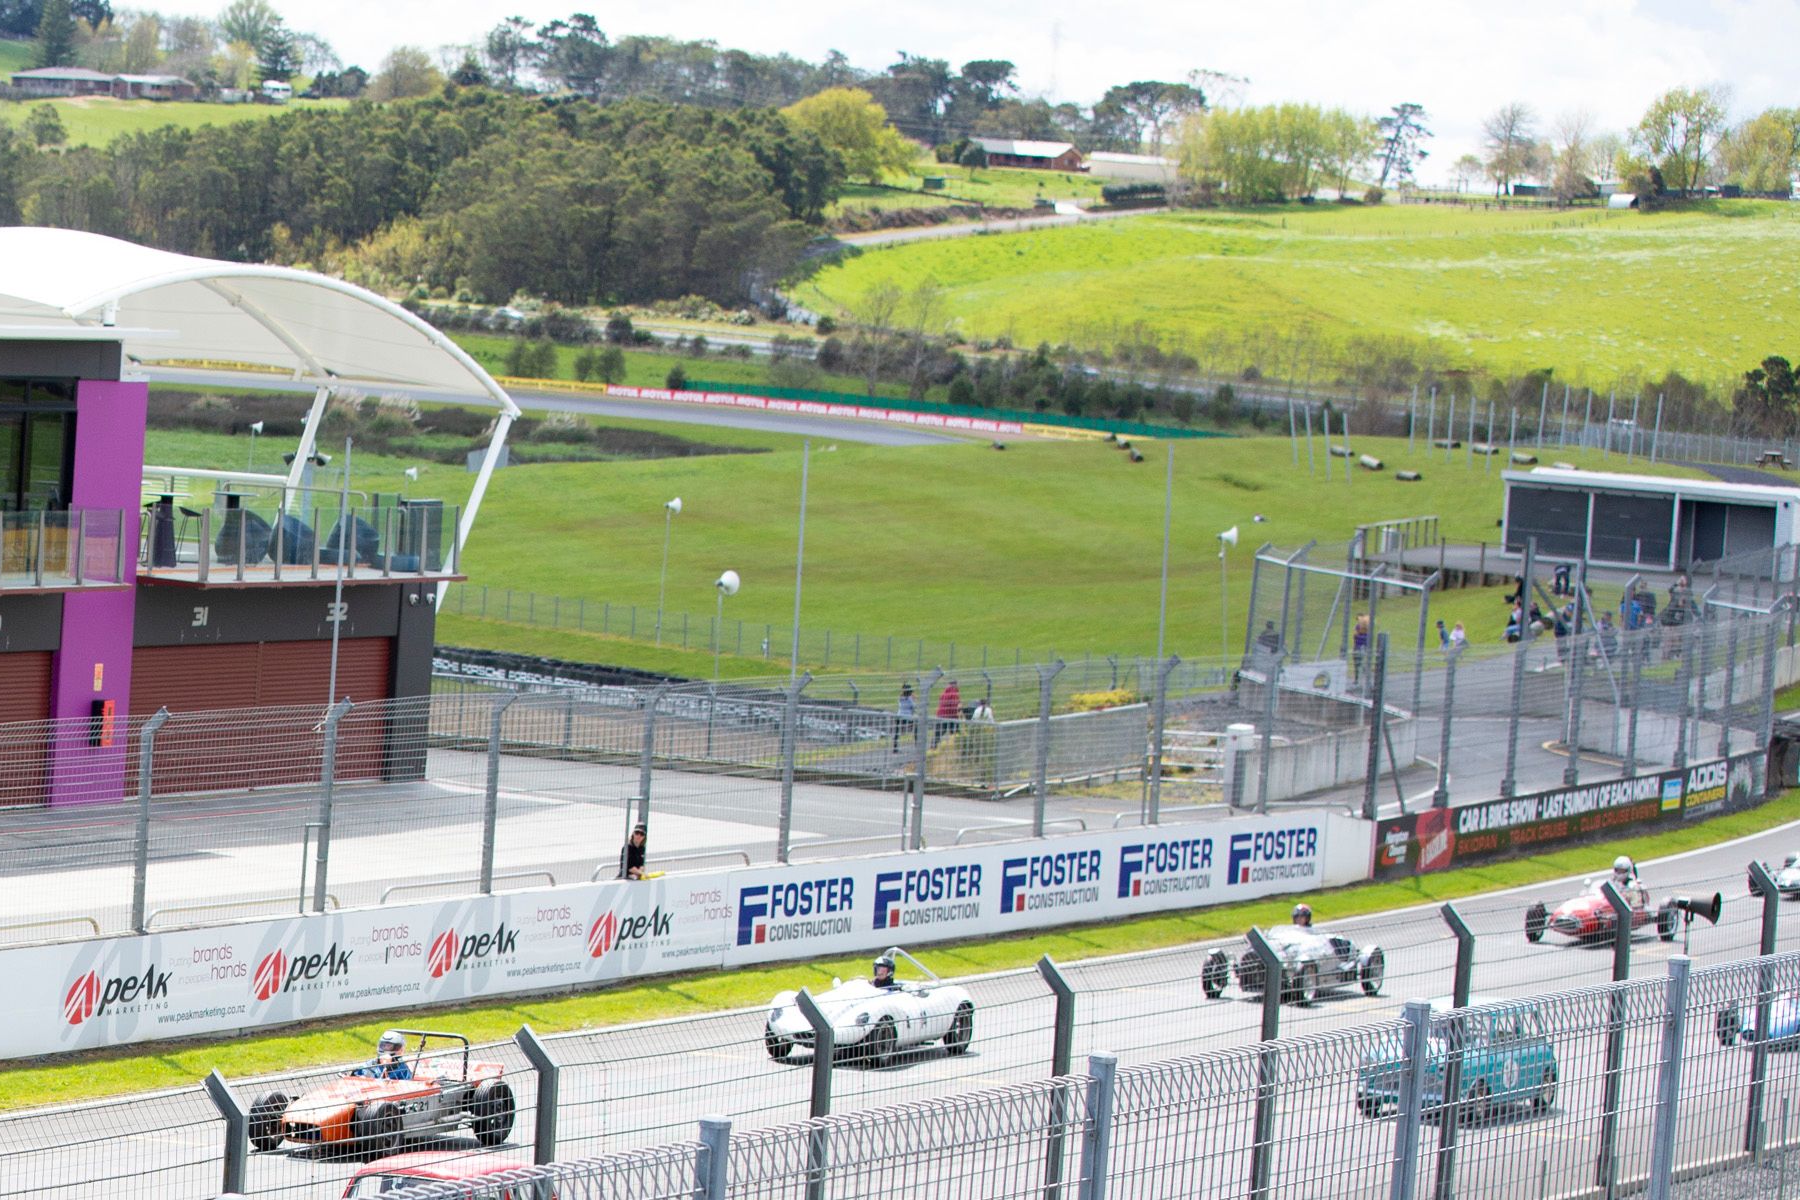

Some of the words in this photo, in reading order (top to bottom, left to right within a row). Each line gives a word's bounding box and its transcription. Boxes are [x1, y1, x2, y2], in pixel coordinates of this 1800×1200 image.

[191, 606, 209, 627] 31
[326, 602, 348, 621] 32
[1687, 762, 1727, 794] ADDIS
[1458, 809, 1480, 834] CAR
[1488, 802, 1509, 828] BIKE
[1510, 797, 1538, 825] SHOW
[1542, 793, 1564, 819] LAST
[1564, 785, 1600, 815] SUNDAY
[1600, 785, 1611, 808] OF
[1611, 780, 1632, 806] EACH
[1633, 775, 1660, 801] MONTH
[1253, 827, 1317, 863] FOSTER
[1510, 826, 1536, 845] TRACK
[1145, 838, 1213, 875] FOSTER
[1029, 849, 1101, 888] FOSTER
[1251, 861, 1315, 882] CONSTRUCTION
[904, 863, 982, 904] FOSTER
[1143, 873, 1210, 896] CONSTRUCTION
[689, 889, 722, 905] brands
[770, 876, 854, 918] FOSTER
[1027, 886, 1099, 910] CONSTRUCTION
[537, 904, 571, 922] brands
[902, 902, 979, 926] CONSTRUCTION
[372, 923, 409, 942] brands
[551, 921, 583, 938] hands
[769, 917, 852, 942] CONSTRUCTION
[193, 943, 233, 964] brands
[387, 940, 422, 958] hands
[210, 961, 247, 980] hands
[463, 958, 516, 970] MARKETING
[292, 978, 350, 992] MARKETING
[339, 982, 421, 1000] www.peakmarketing.co.nz
[106, 1001, 169, 1016] MARKETING
[158, 1004, 246, 1024] www.peakmarketing.co.nz
